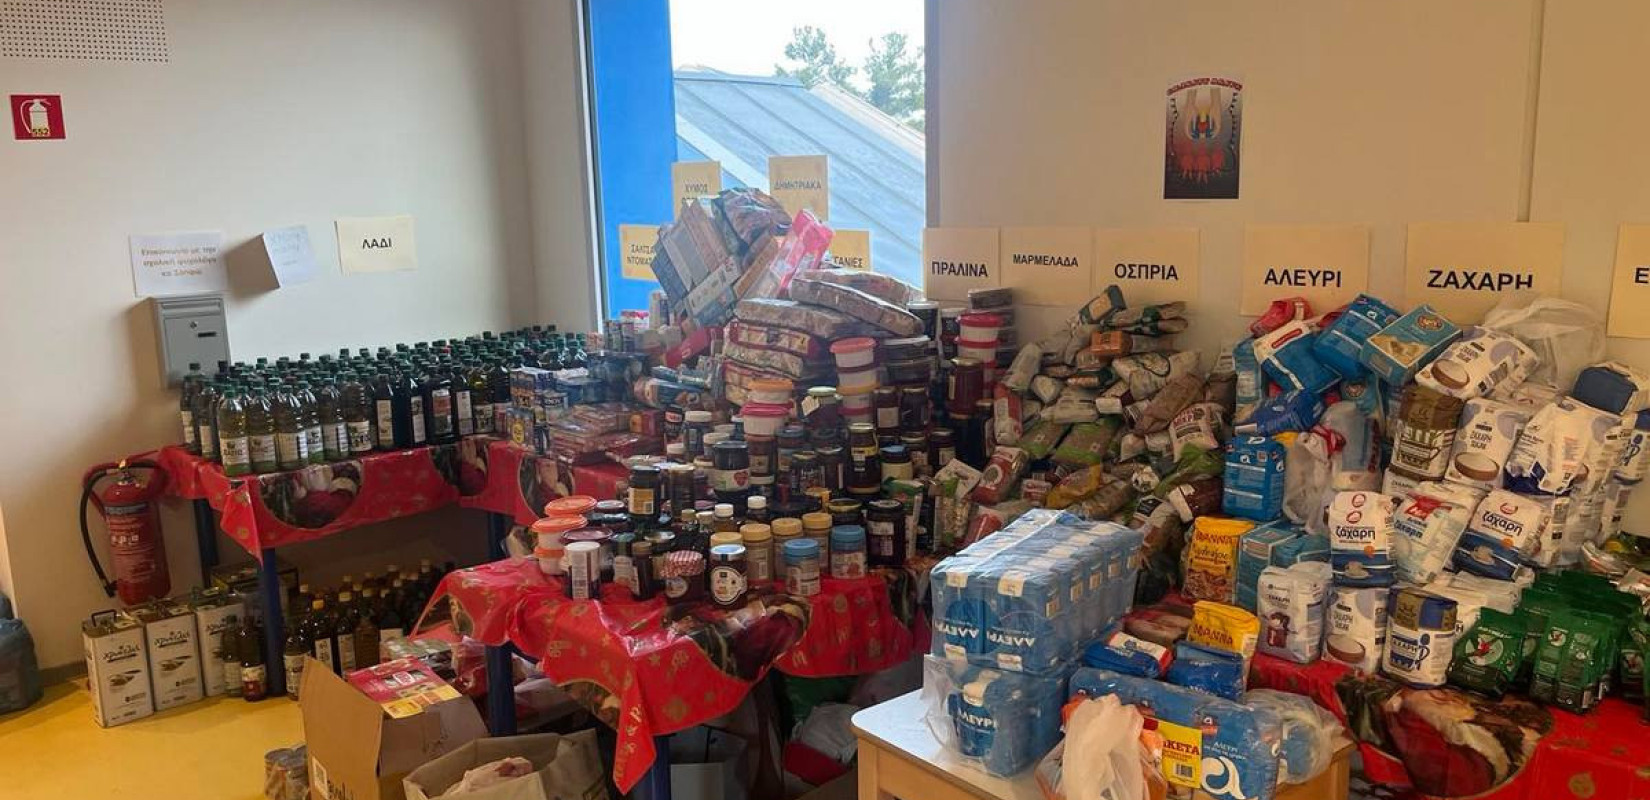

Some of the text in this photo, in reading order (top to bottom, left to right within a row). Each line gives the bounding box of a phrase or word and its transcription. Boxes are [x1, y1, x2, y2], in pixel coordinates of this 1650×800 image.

[684, 183, 708, 194] ΧΥΜΟΣ
[774, 180, 822, 190] ΔΗΜΗΤΡΙΑΚΑ
[361, 237, 393, 250] ΛΑΔΙ
[832, 256, 863, 268] ΓΑΝΙΕΣ
[1012, 253, 1079, 268] ΜΑΡΜΕΛΑΔΑ
[931, 260, 989, 278] ΠΡΑΛΙΝΑ
[1114, 263, 1179, 281] ΟΣΠΡΙΑ
[1263, 268, 1342, 288] ΑΛΕΥΡΙ
[1426, 269, 1534, 291] ΖΑΧΑΡΗ
[1482, 509, 1524, 537] ζάχαρη
[1335, 525, 1376, 540] ζάχαρη
[1163, 739, 1200, 756] ΚΕΤΑ
